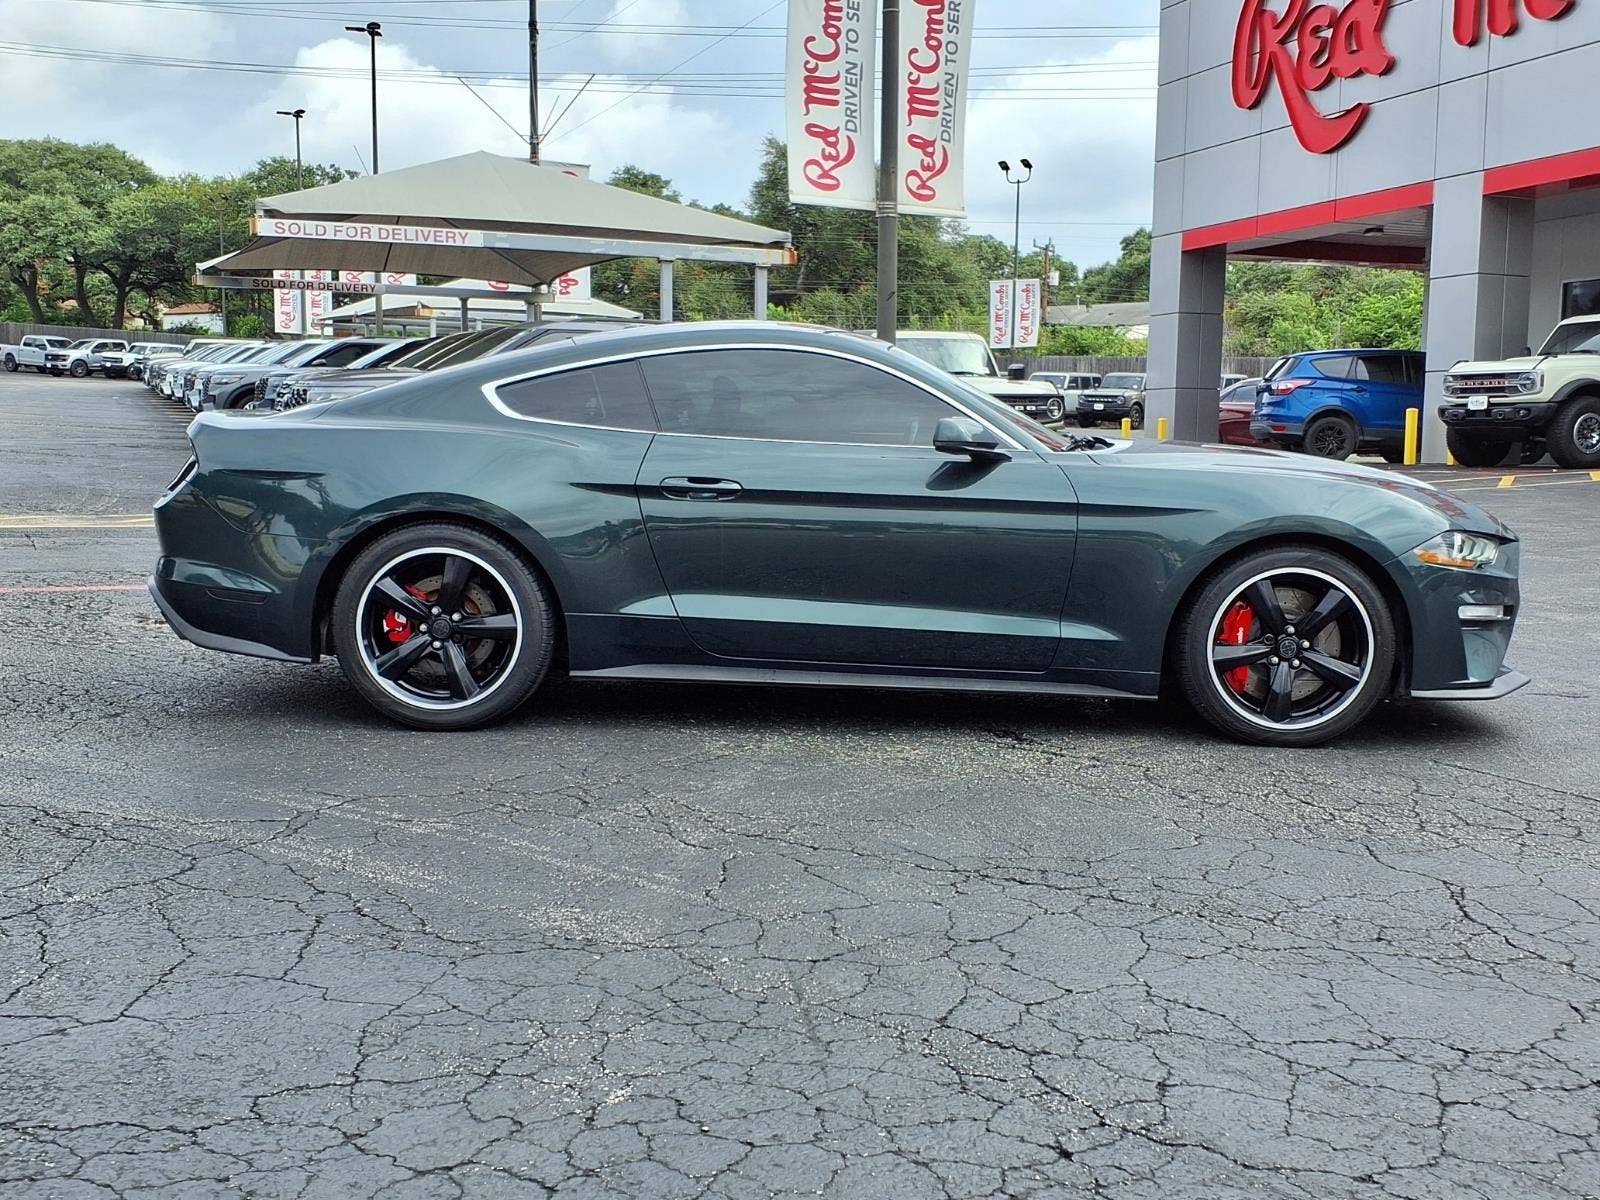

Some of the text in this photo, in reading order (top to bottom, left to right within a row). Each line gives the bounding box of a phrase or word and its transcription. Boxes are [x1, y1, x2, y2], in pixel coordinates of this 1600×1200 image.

[845, 28, 860, 55] TO
[945, 40, 959, 67] TO
[845, 60, 861, 135] DRIVEN
[940, 72, 957, 144] DRIVEN
[803, 123, 855, 192] Red
[905, 134, 948, 202] Red
[274, 221, 469, 244] SOLD FOR DELIVERY
[252, 278, 377, 293] SOLD FOR DELIVERY
